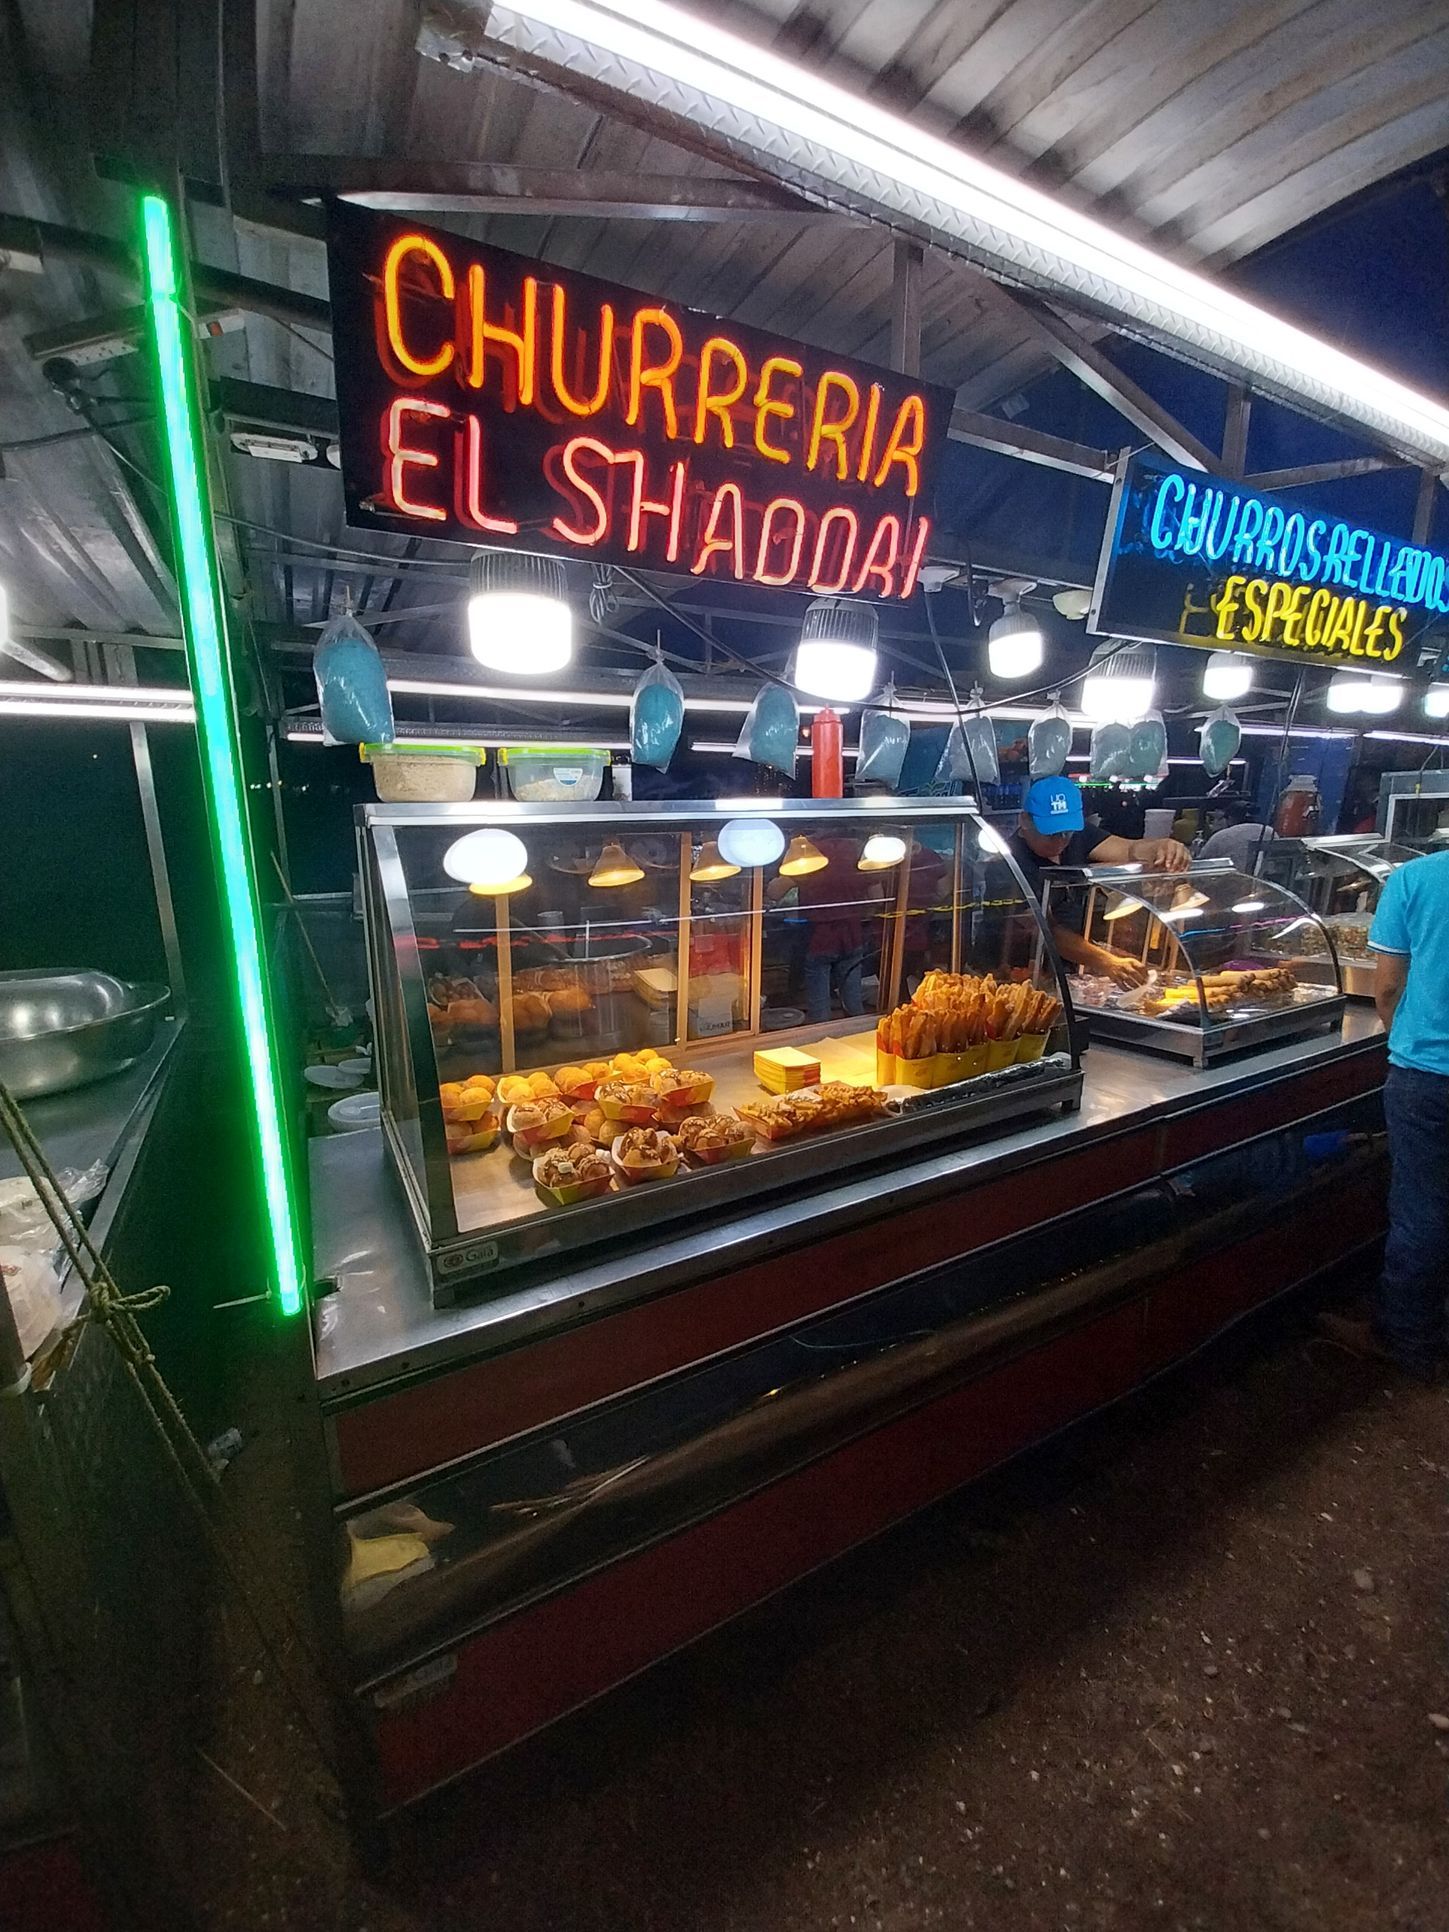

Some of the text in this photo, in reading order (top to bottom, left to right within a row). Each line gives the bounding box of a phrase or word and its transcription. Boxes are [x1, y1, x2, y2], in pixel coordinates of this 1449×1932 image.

[382, 233, 925, 497] CHURRERIA
[387, 397, 519, 535] EL
[1150, 473, 1327, 582] CHURROS
[1216, 575, 1409, 662] ESPECIALES
